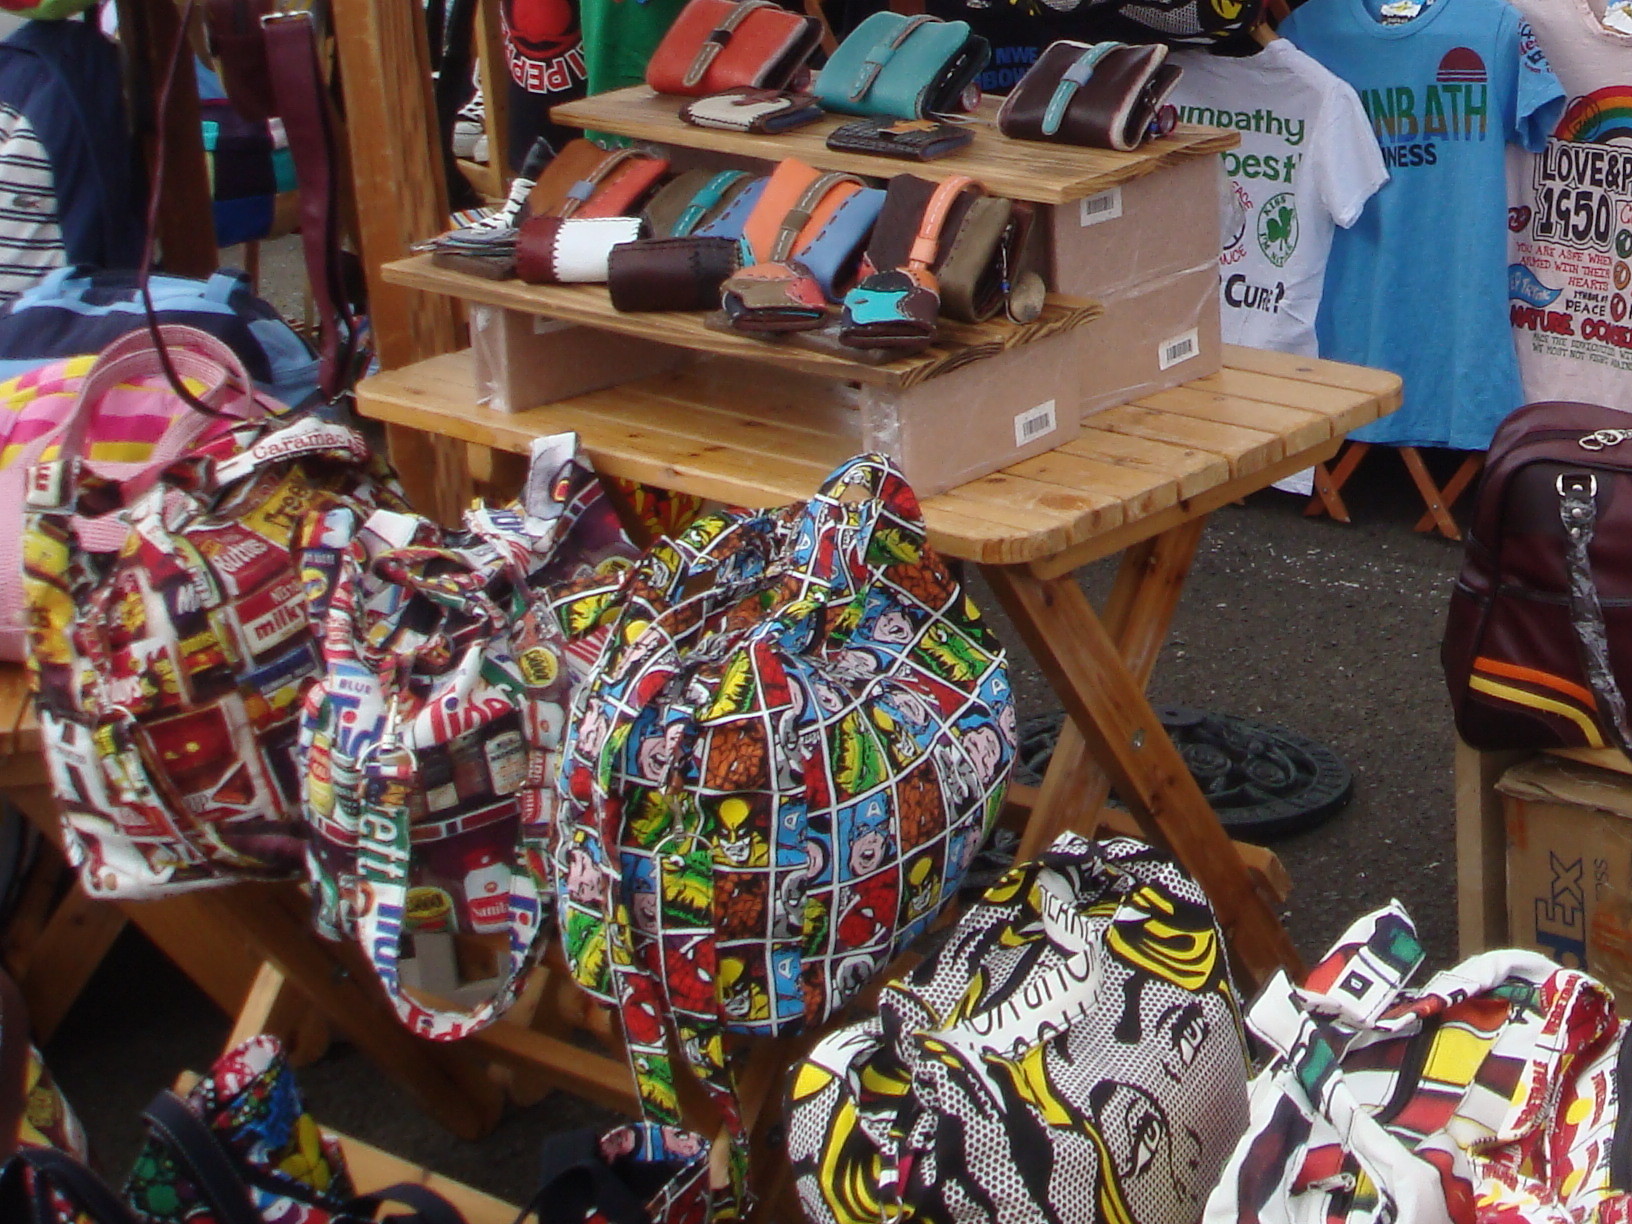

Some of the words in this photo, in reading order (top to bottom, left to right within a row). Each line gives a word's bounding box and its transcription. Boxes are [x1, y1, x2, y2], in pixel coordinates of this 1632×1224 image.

[996, 46, 1038, 64] NWE
[1361, 84, 1488, 143] NBATH
[1178, 105, 1305, 146] mpathy
[1540, 188, 1611, 242] 1950
[1536, 244, 1554, 257] ARE
[1588, 253, 1613, 266] WHEN
[1568, 277, 1609, 292] HEARTS
[1565, 299, 1606, 317] PEACE
[339, 679, 373, 696] BLUE
[1535, 850, 1588, 970] dEx
